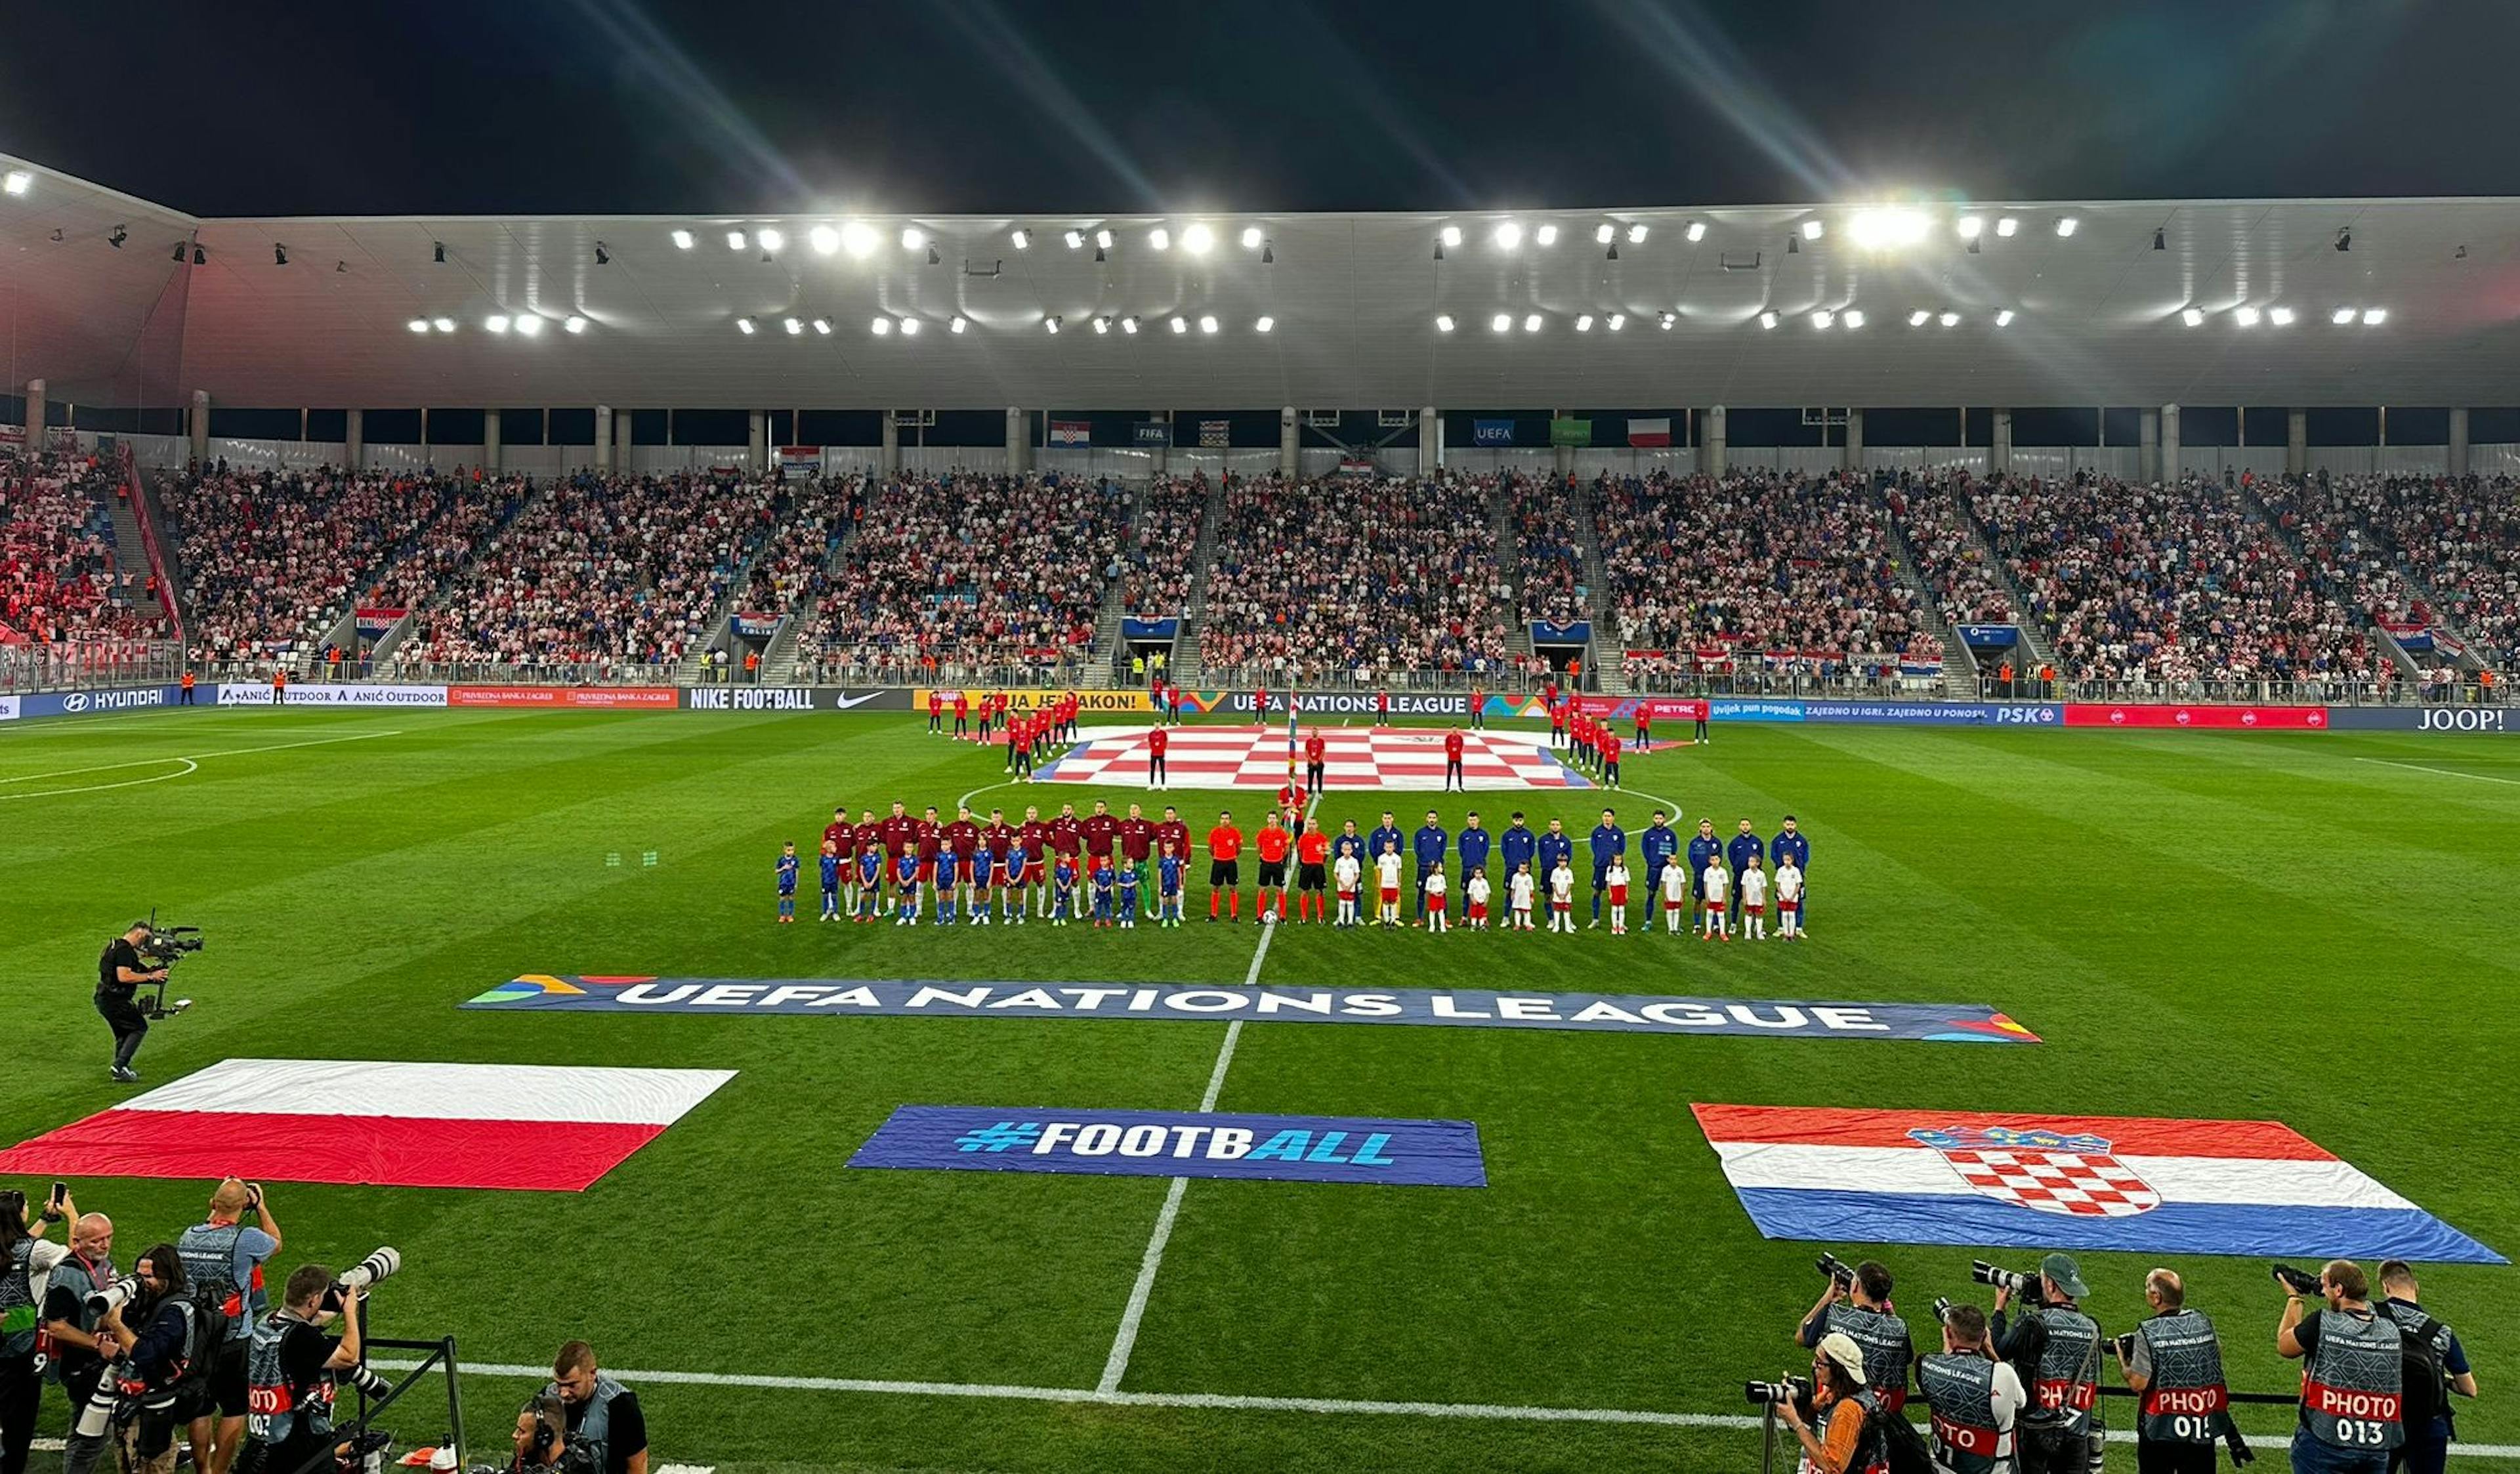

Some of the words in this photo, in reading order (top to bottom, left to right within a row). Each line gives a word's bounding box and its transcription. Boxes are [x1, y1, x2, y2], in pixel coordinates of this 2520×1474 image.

[1140, 429, 1163, 438] FIFA
[1477, 428, 1511, 440] UEFA
[95, 689, 163, 709] HYUNDAI
[242, 689, 270, 701] ANIĆ
[284, 692, 331, 701] UTDOOR
[353, 690, 383, 702] ANIĆ
[386, 692, 446, 702] OUTDOOR
[690, 688, 730, 709] NIKE
[733, 688, 814, 710] FOOTBALL
[984, 691, 1030, 708] ŽJA
[1078, 695, 1136, 709] AKON!
[1234, 695, 1284, 711] UEFA
[1292, 696, 1378, 712] NATIONS
[1387, 696, 1466, 713] LEAGUE
[1713, 704, 1740, 715] Uvijek
[1742, 704, 1760, 713] pun
[1762, 704, 1801, 716] pogodak
[1805, 706, 1851, 717] ZAJEDNO
[1852, 707, 1860, 715] U
[1887, 708, 1930, 718] ZAJEDNO
[1933, 709, 1941, 717] U
[1996, 707, 2040, 723] PSK
[2417, 709, 2504, 730] JOOP!
[615, 983, 881, 1007] UEFA
[904, 986, 1403, 1017] NATIONS
[1431, 996, 1891, 1030] LEAGUE
[954, 1121, 1394, 1166] #FOOTBALL
[1847, 1330, 1879, 1345] NATIONS
[2324, 1334, 2345, 1344] UEFA
[2346, 1339, 2377, 1349] NATIONS
[1952, 1369, 1982, 1385] LEAGUE
[2159, 1389, 2217, 1412] PHOTO
[2322, 1389, 2396, 1418] PHOTO
[2337, 1418, 2384, 1444] 013
